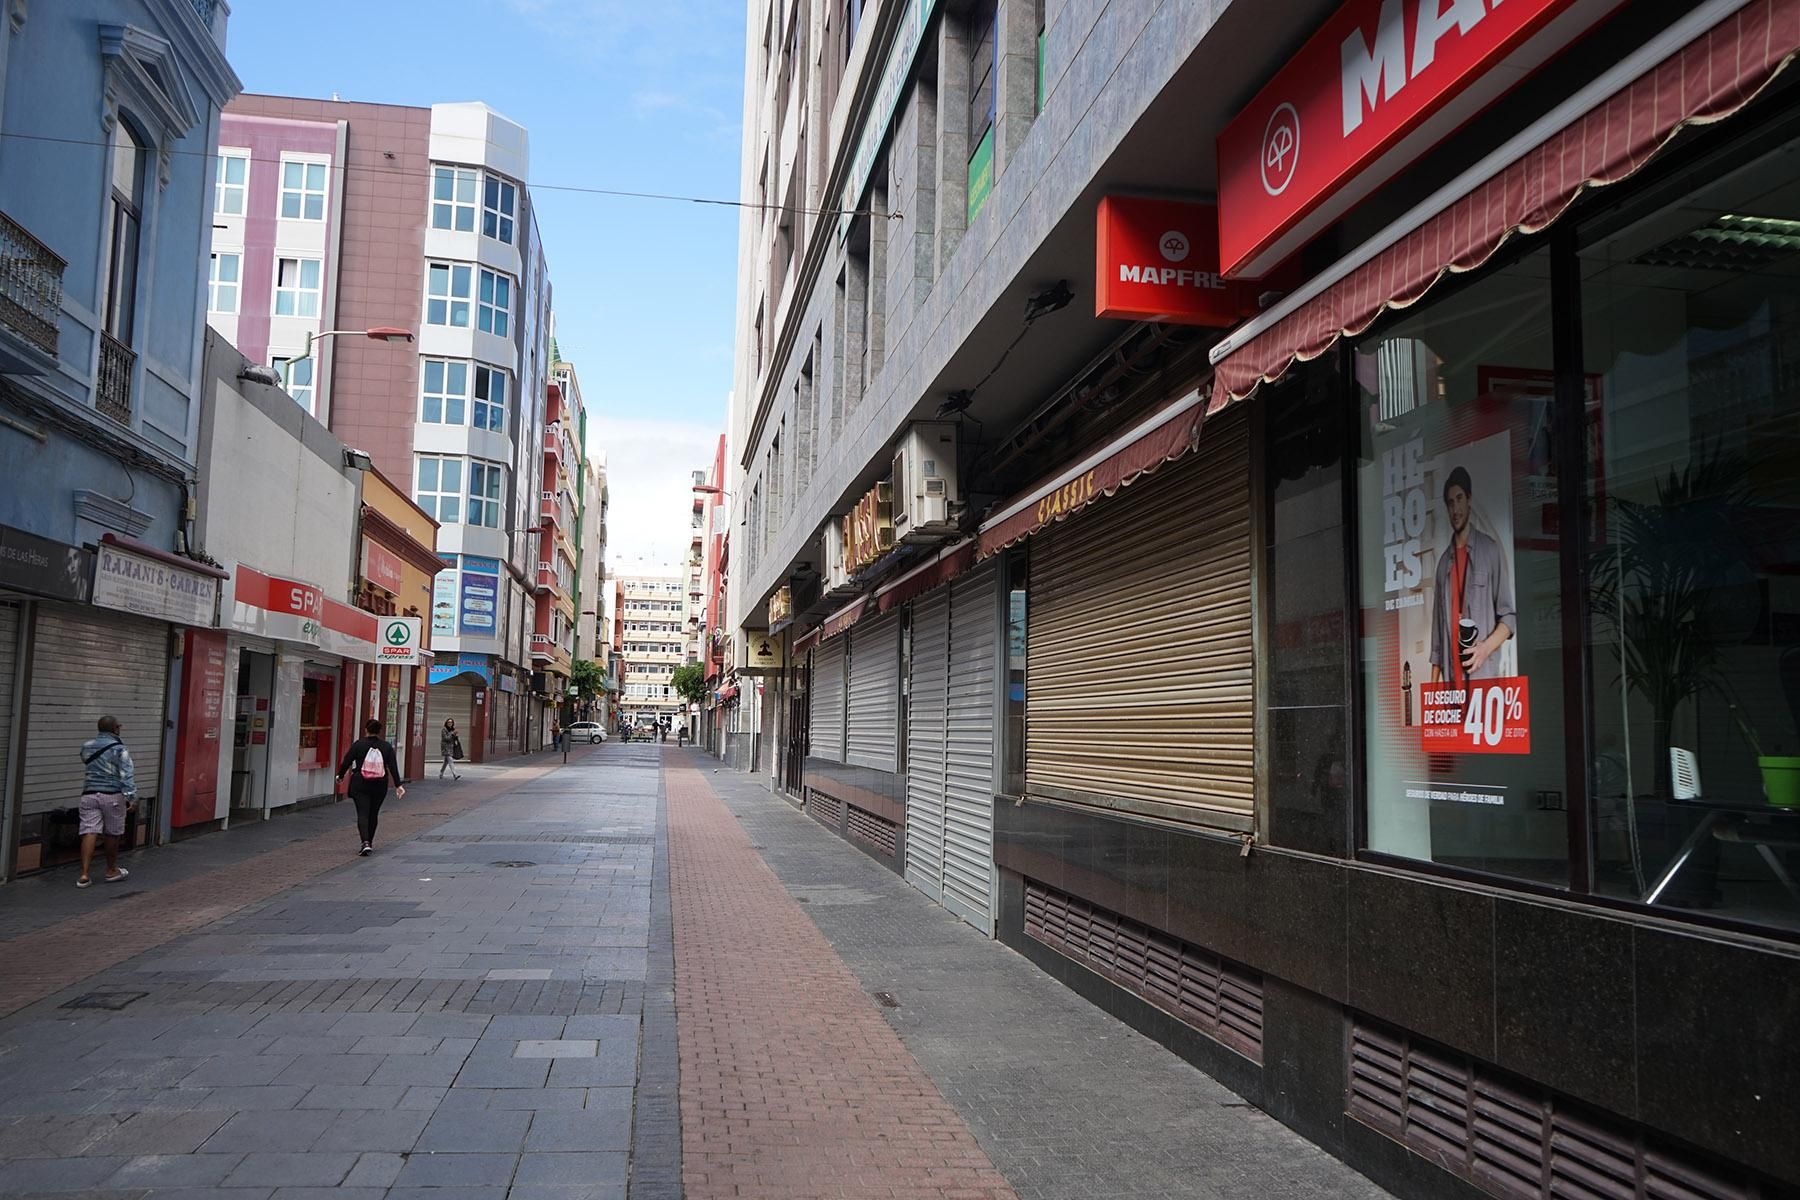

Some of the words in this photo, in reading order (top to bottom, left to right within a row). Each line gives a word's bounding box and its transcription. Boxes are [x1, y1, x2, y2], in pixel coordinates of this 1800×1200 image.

[1340, 0, 1506, 138] MA
[1119, 264, 1227, 290] MAPFRE
[1038, 470, 1095, 523] CLASSIC
[1423, 691, 1434, 706] TU
[1434, 690, 1466, 706] SEGURO
[1424, 710, 1434, 724] DE
[1435, 709, 1461, 724] COCHE
[1424, 729, 1434, 738] CON
[1434, 728, 1450, 738] HASTA
[1450, 728, 1458, 737] UN
[1505, 728, 1512, 738] DE
